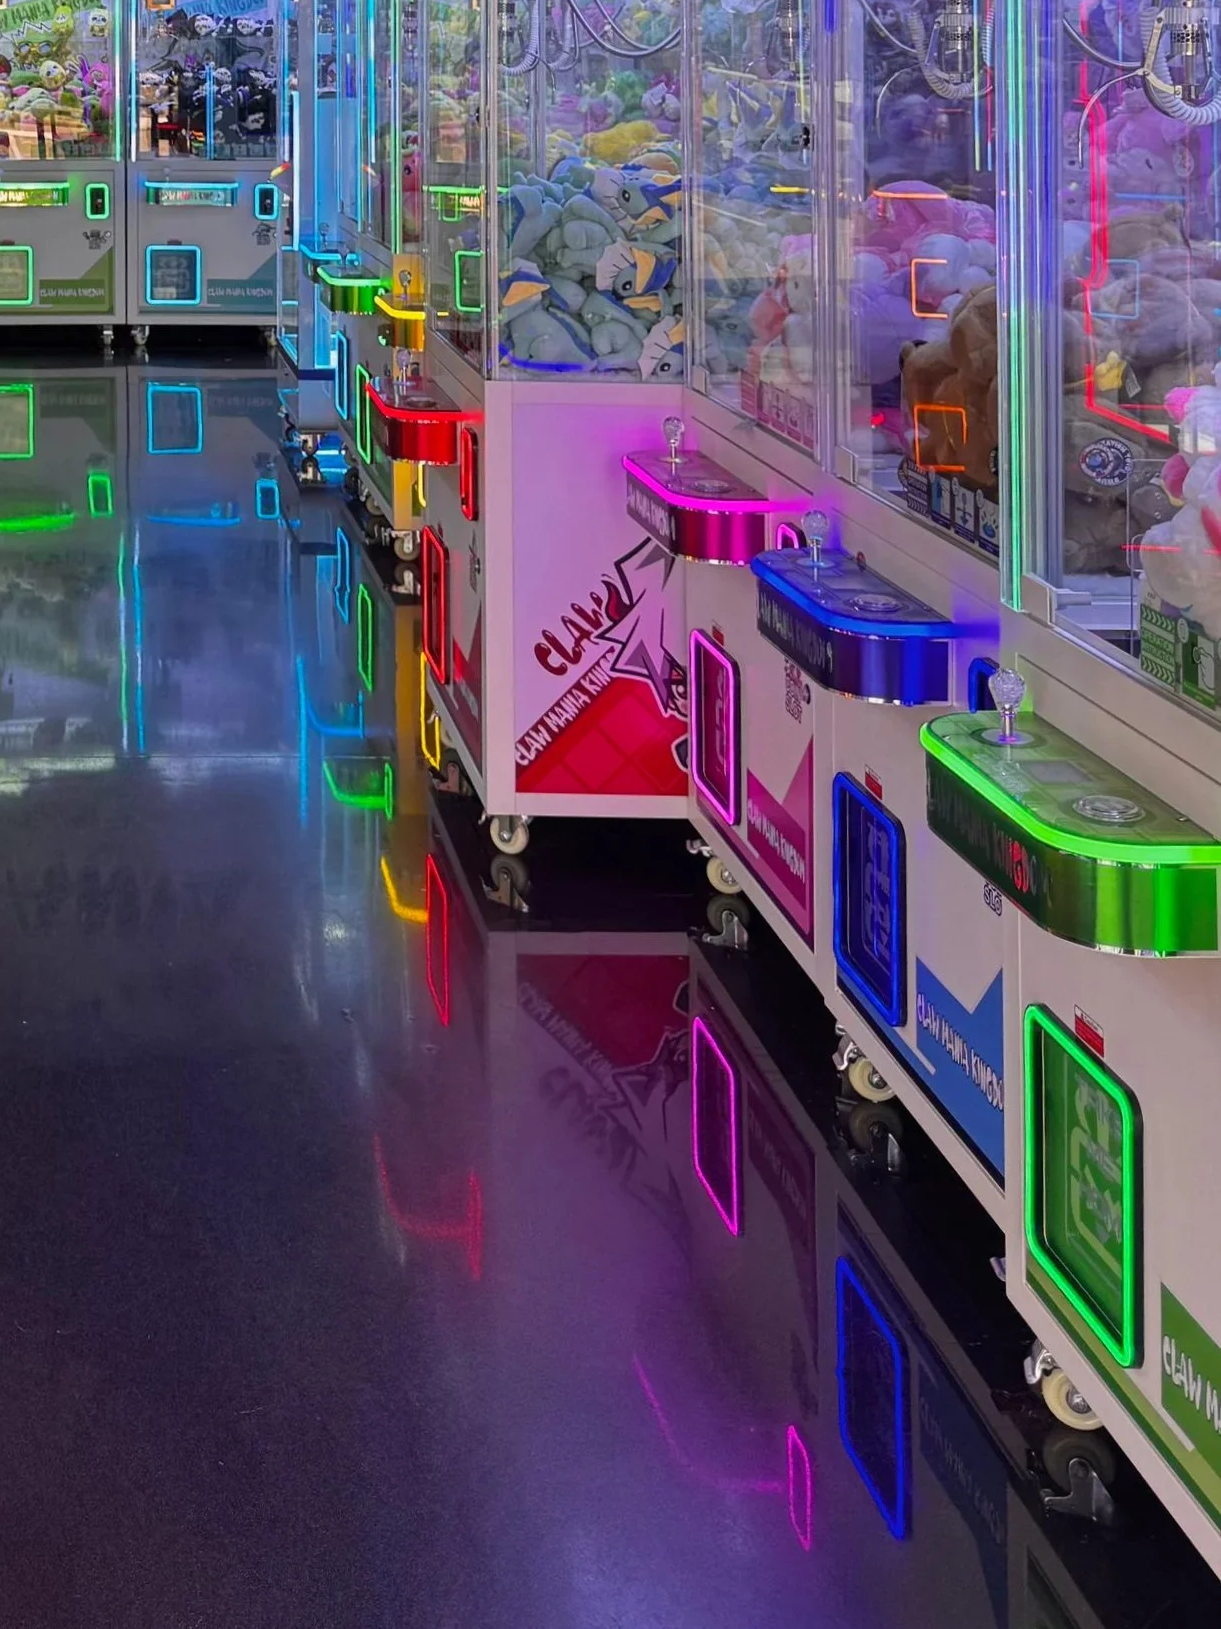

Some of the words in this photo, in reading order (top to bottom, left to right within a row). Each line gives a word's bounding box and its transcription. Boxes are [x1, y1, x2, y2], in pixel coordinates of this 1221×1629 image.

[533, 590, 604, 676] CLAW
[515, 728, 553, 766] CLAW
[547, 687, 592, 733] MANIA
[916, 992, 941, 1048] CLAW
[941, 1018, 970, 1078] MANIA
[1162, 1335, 1203, 1412] CLAW
